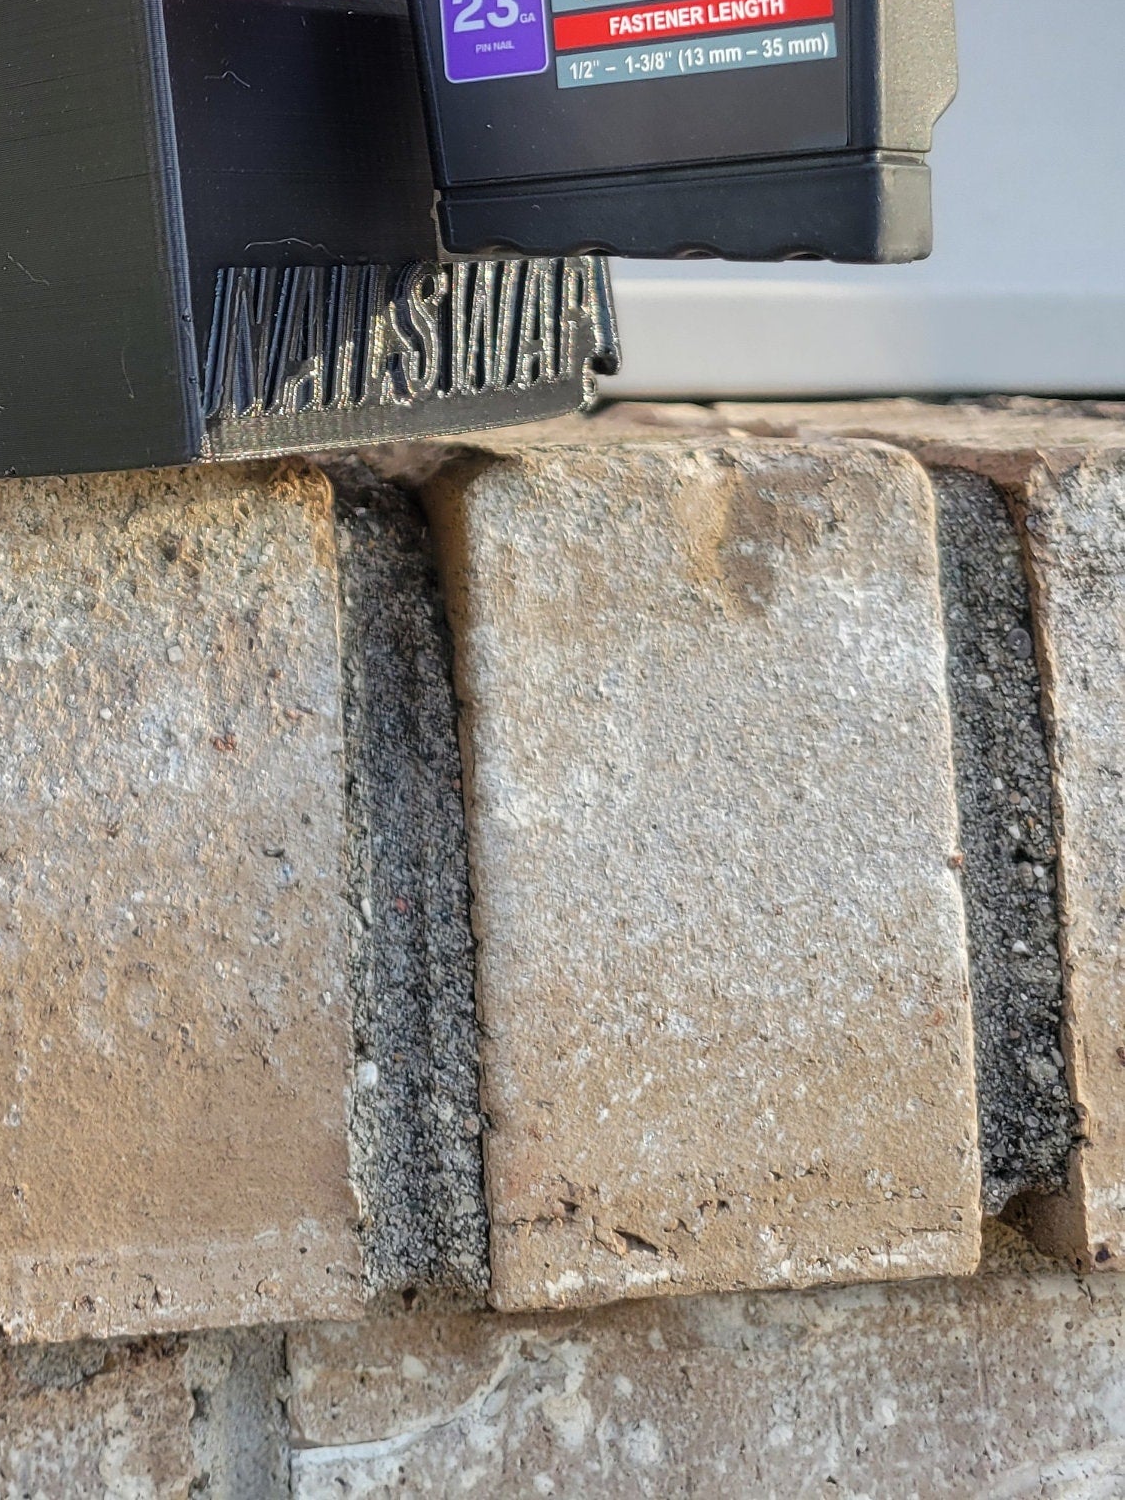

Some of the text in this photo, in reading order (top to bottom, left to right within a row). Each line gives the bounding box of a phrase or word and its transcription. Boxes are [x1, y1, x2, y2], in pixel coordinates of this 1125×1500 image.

[519, 12, 536, 25] GA
[608, 6, 705, 37] FASTENER
[475, 40, 516, 54] PIN NAIL
[569, 59, 601, 81] 1/2"
[678, 45, 705, 72] (13
[708, 47, 743, 65] mm
[761, 37, 783, 60] 35
[786, 30, 829, 58] mm)
